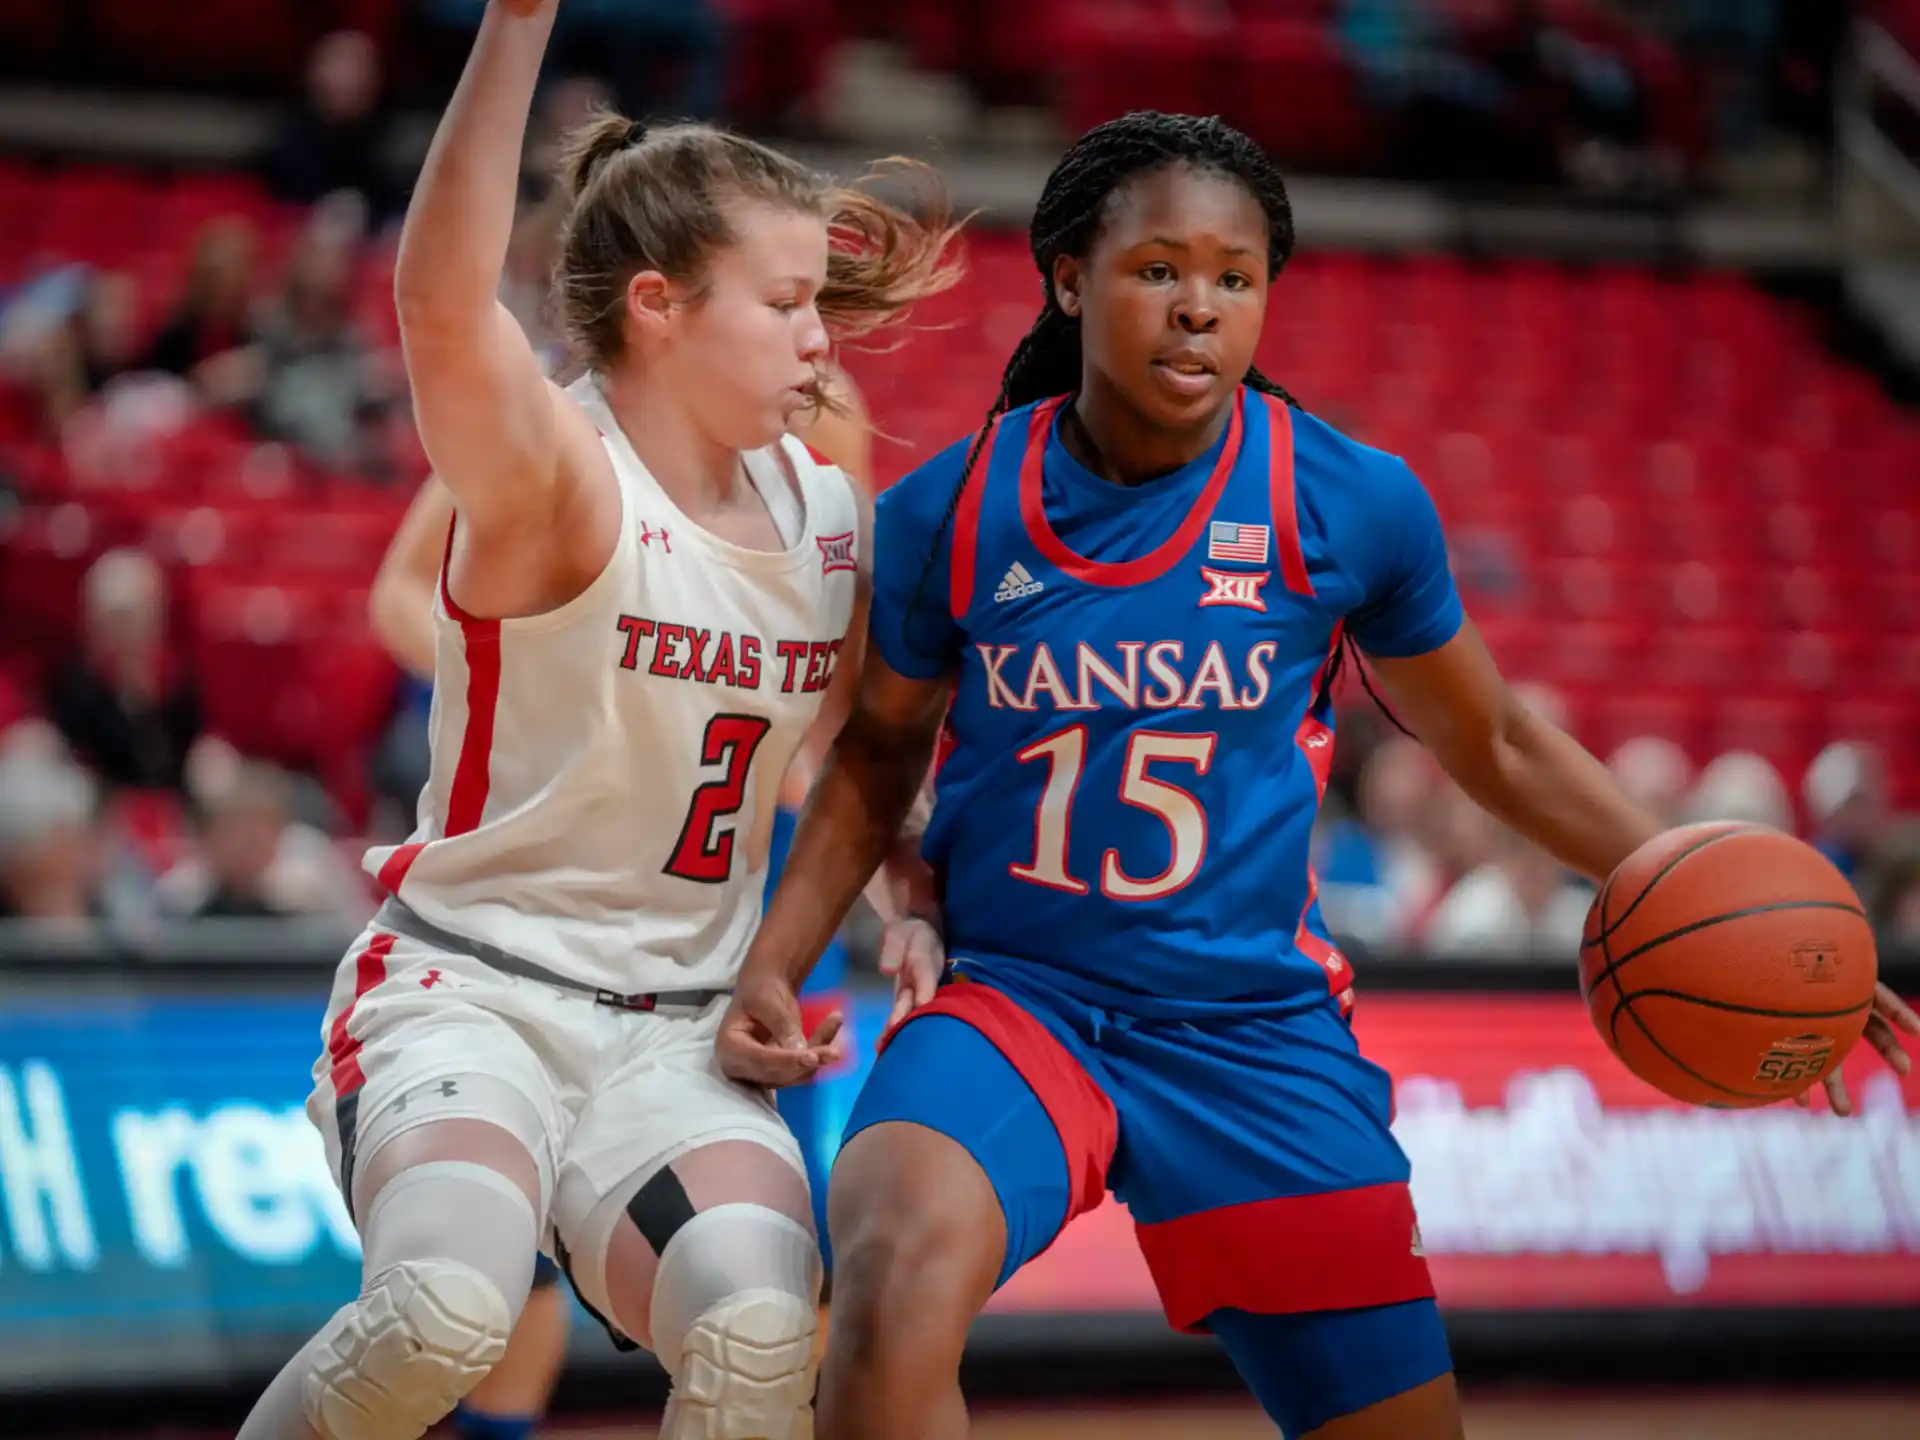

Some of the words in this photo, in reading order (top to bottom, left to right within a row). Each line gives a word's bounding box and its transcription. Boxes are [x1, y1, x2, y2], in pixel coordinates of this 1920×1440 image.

[994, 581, 1044, 602] adidas
[1199, 567, 1270, 613] XII
[617, 614, 761, 690] TEXAS
[976, 640, 1278, 712] KANSAS
[661, 712, 772, 884] 2
[1009, 724, 1218, 901] 15
